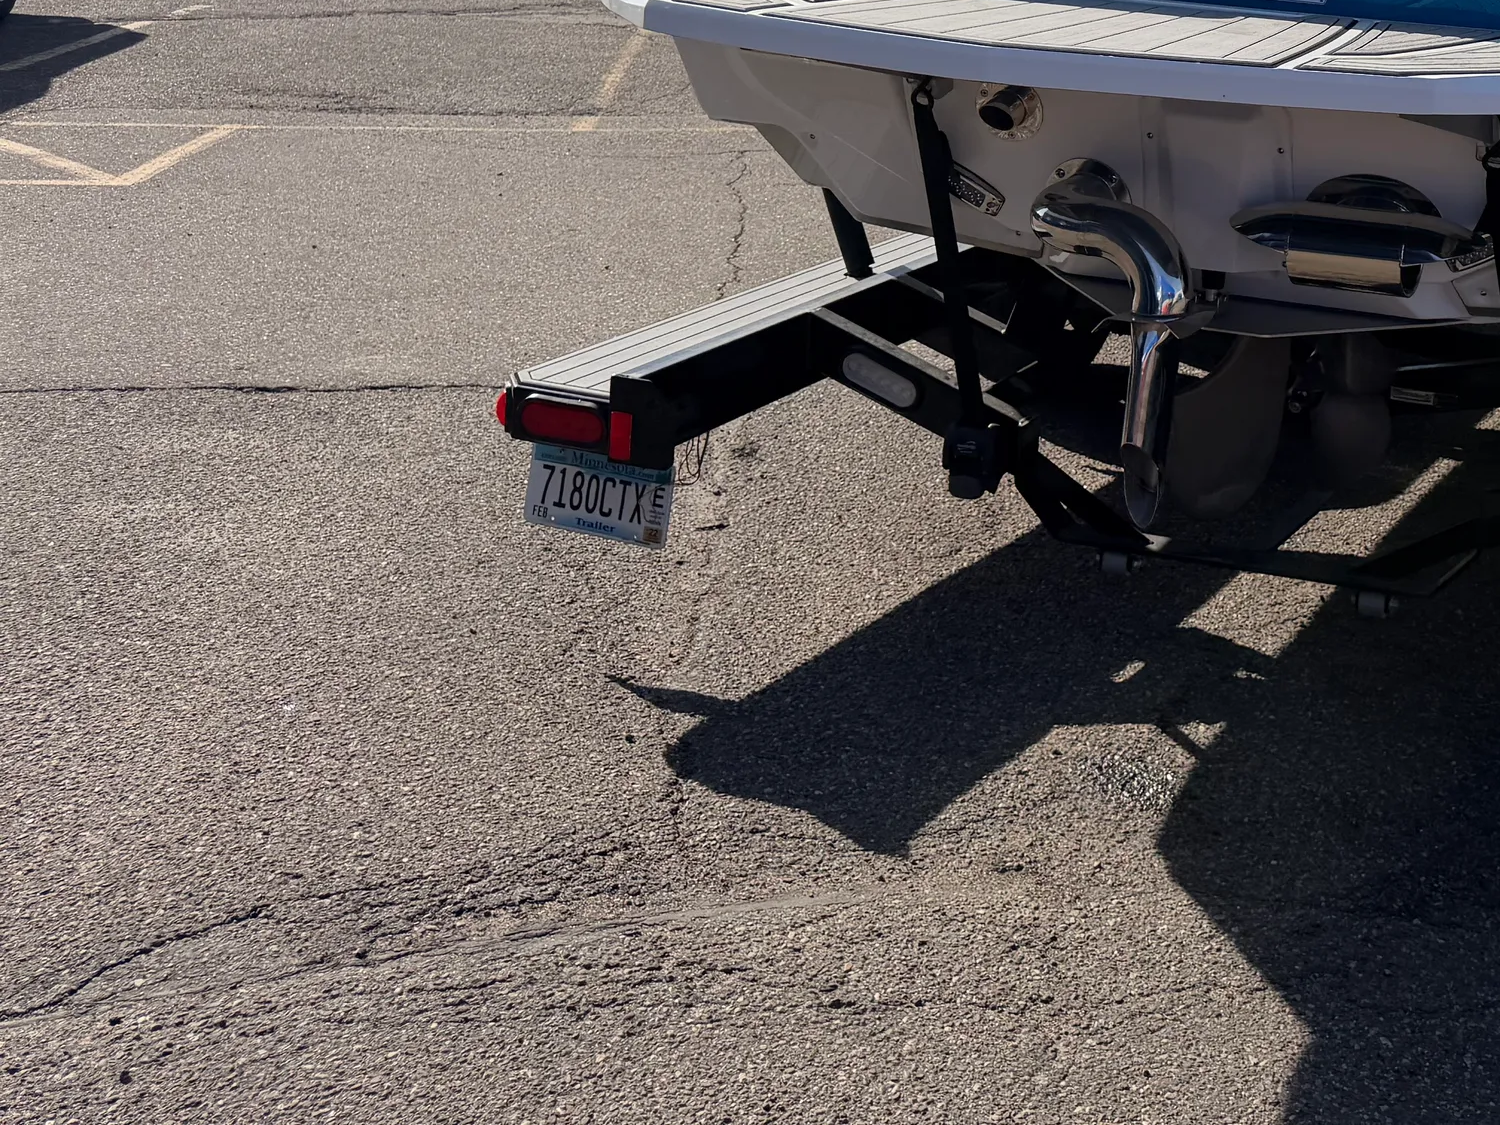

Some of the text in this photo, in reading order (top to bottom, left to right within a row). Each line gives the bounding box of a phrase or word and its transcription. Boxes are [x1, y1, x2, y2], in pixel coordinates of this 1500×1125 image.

[540, 463, 647, 525] 7180CTX
[532, 504, 549, 519] FEB
[575, 517, 616, 533] Trailer
